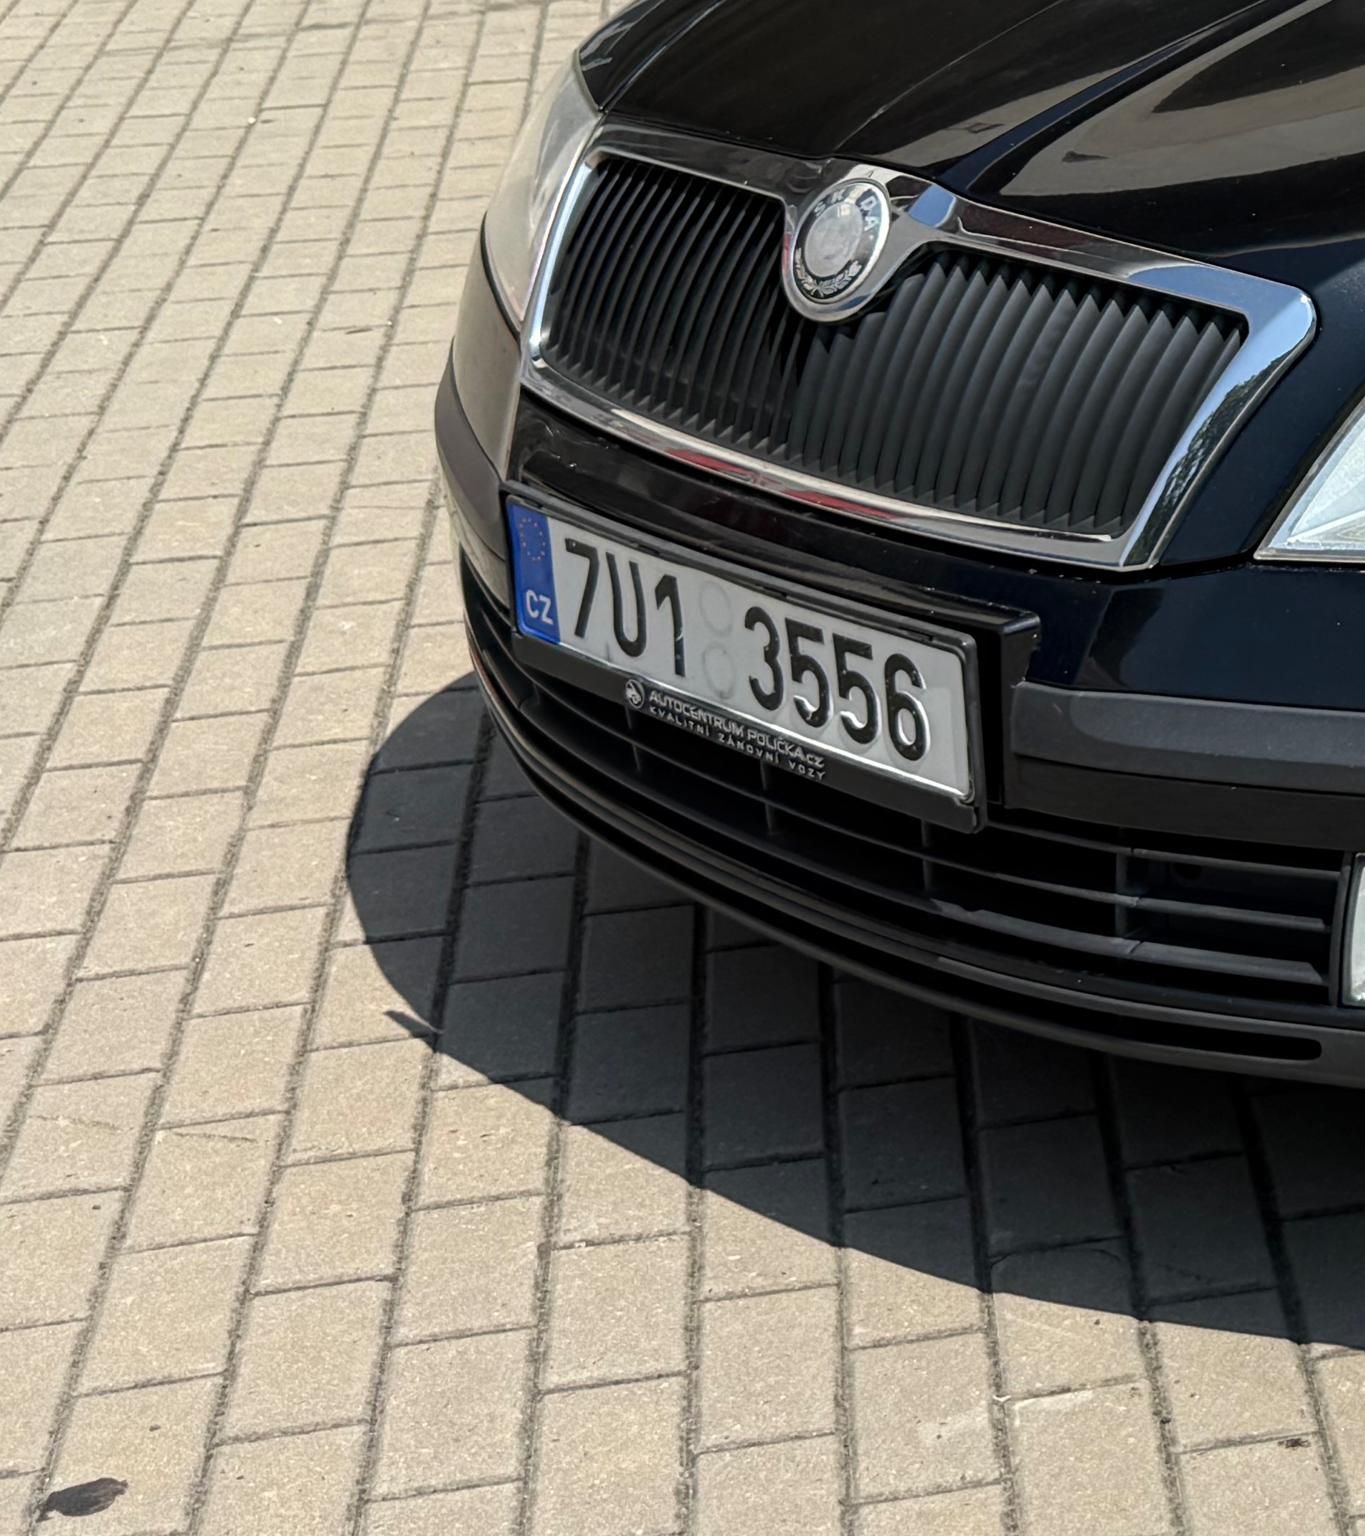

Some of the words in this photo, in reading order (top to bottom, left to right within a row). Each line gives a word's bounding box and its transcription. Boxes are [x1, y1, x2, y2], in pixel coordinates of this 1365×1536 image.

[526, 589, 553, 625] CZ
[565, 537, 685, 677] 7U1
[744, 606, 930, 762] 3556
[649, 690, 744, 737] AUTOCENTRUM
[788, 759, 826, 781] VOZY
